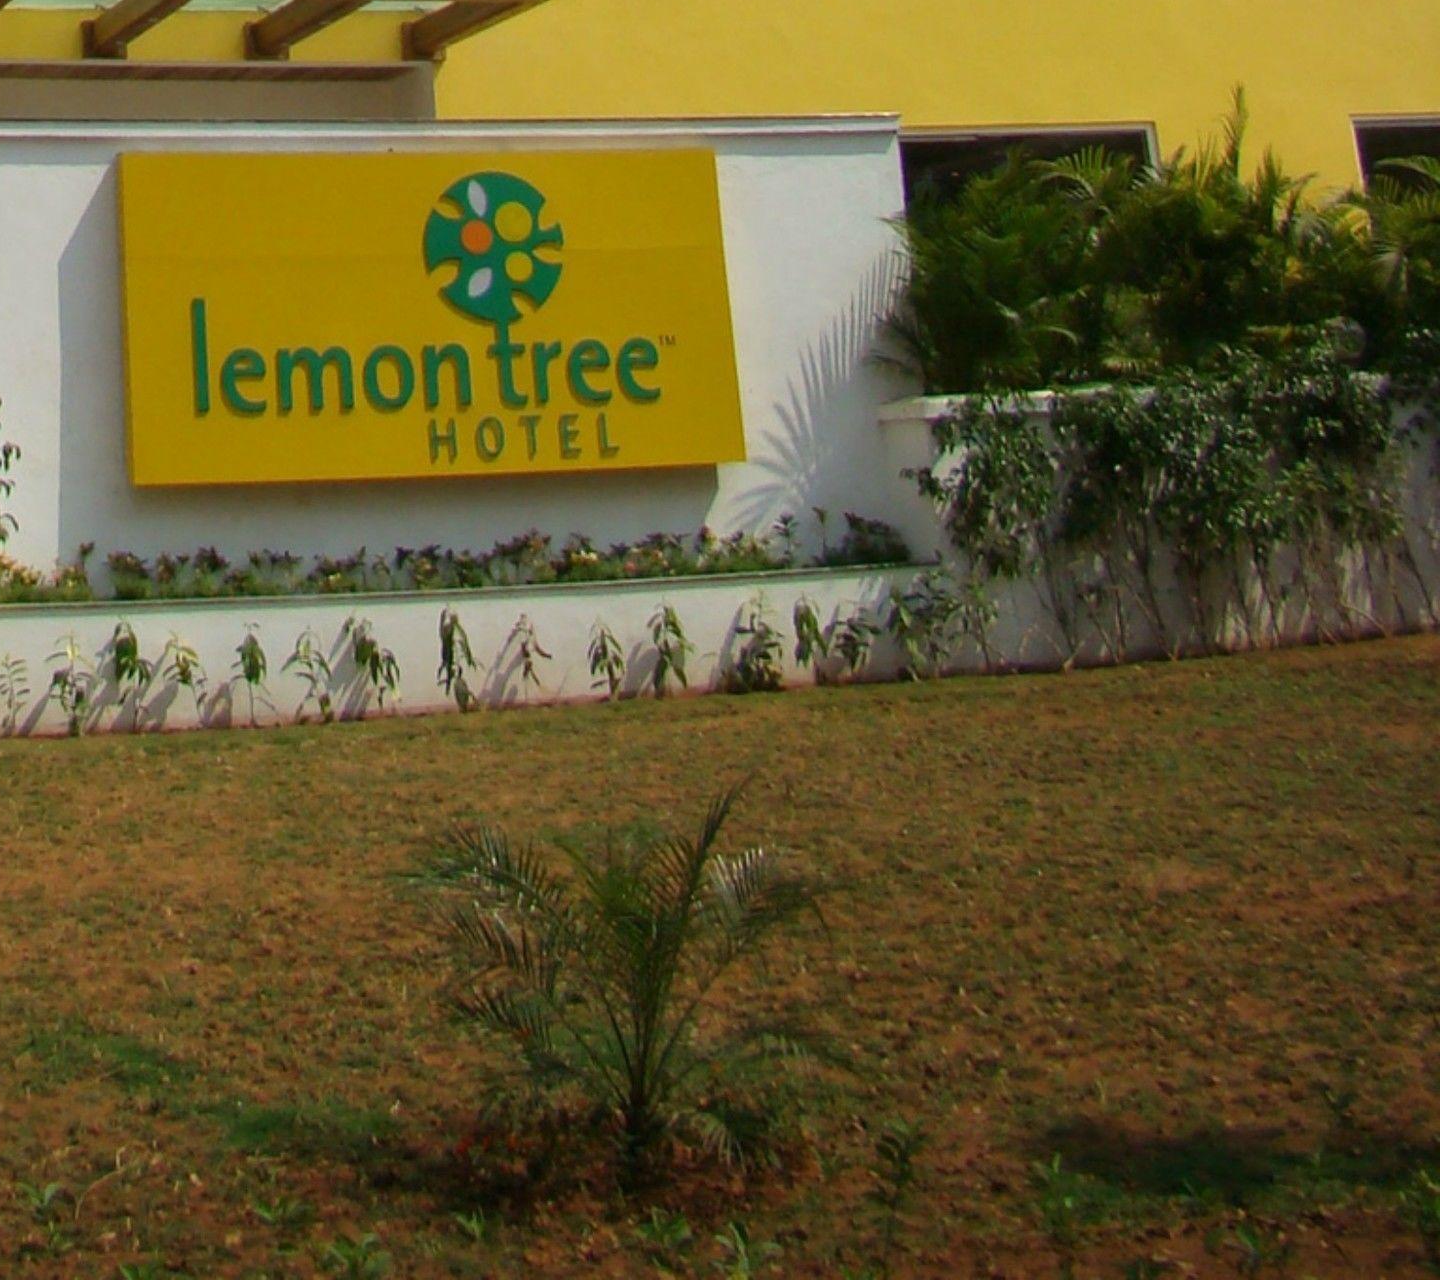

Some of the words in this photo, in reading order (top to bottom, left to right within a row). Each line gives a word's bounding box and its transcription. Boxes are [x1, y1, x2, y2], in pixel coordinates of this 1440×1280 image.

[191, 297, 471, 415] lemon
[488, 323, 661, 407] tree
[427, 412, 621, 463] HOTEL
